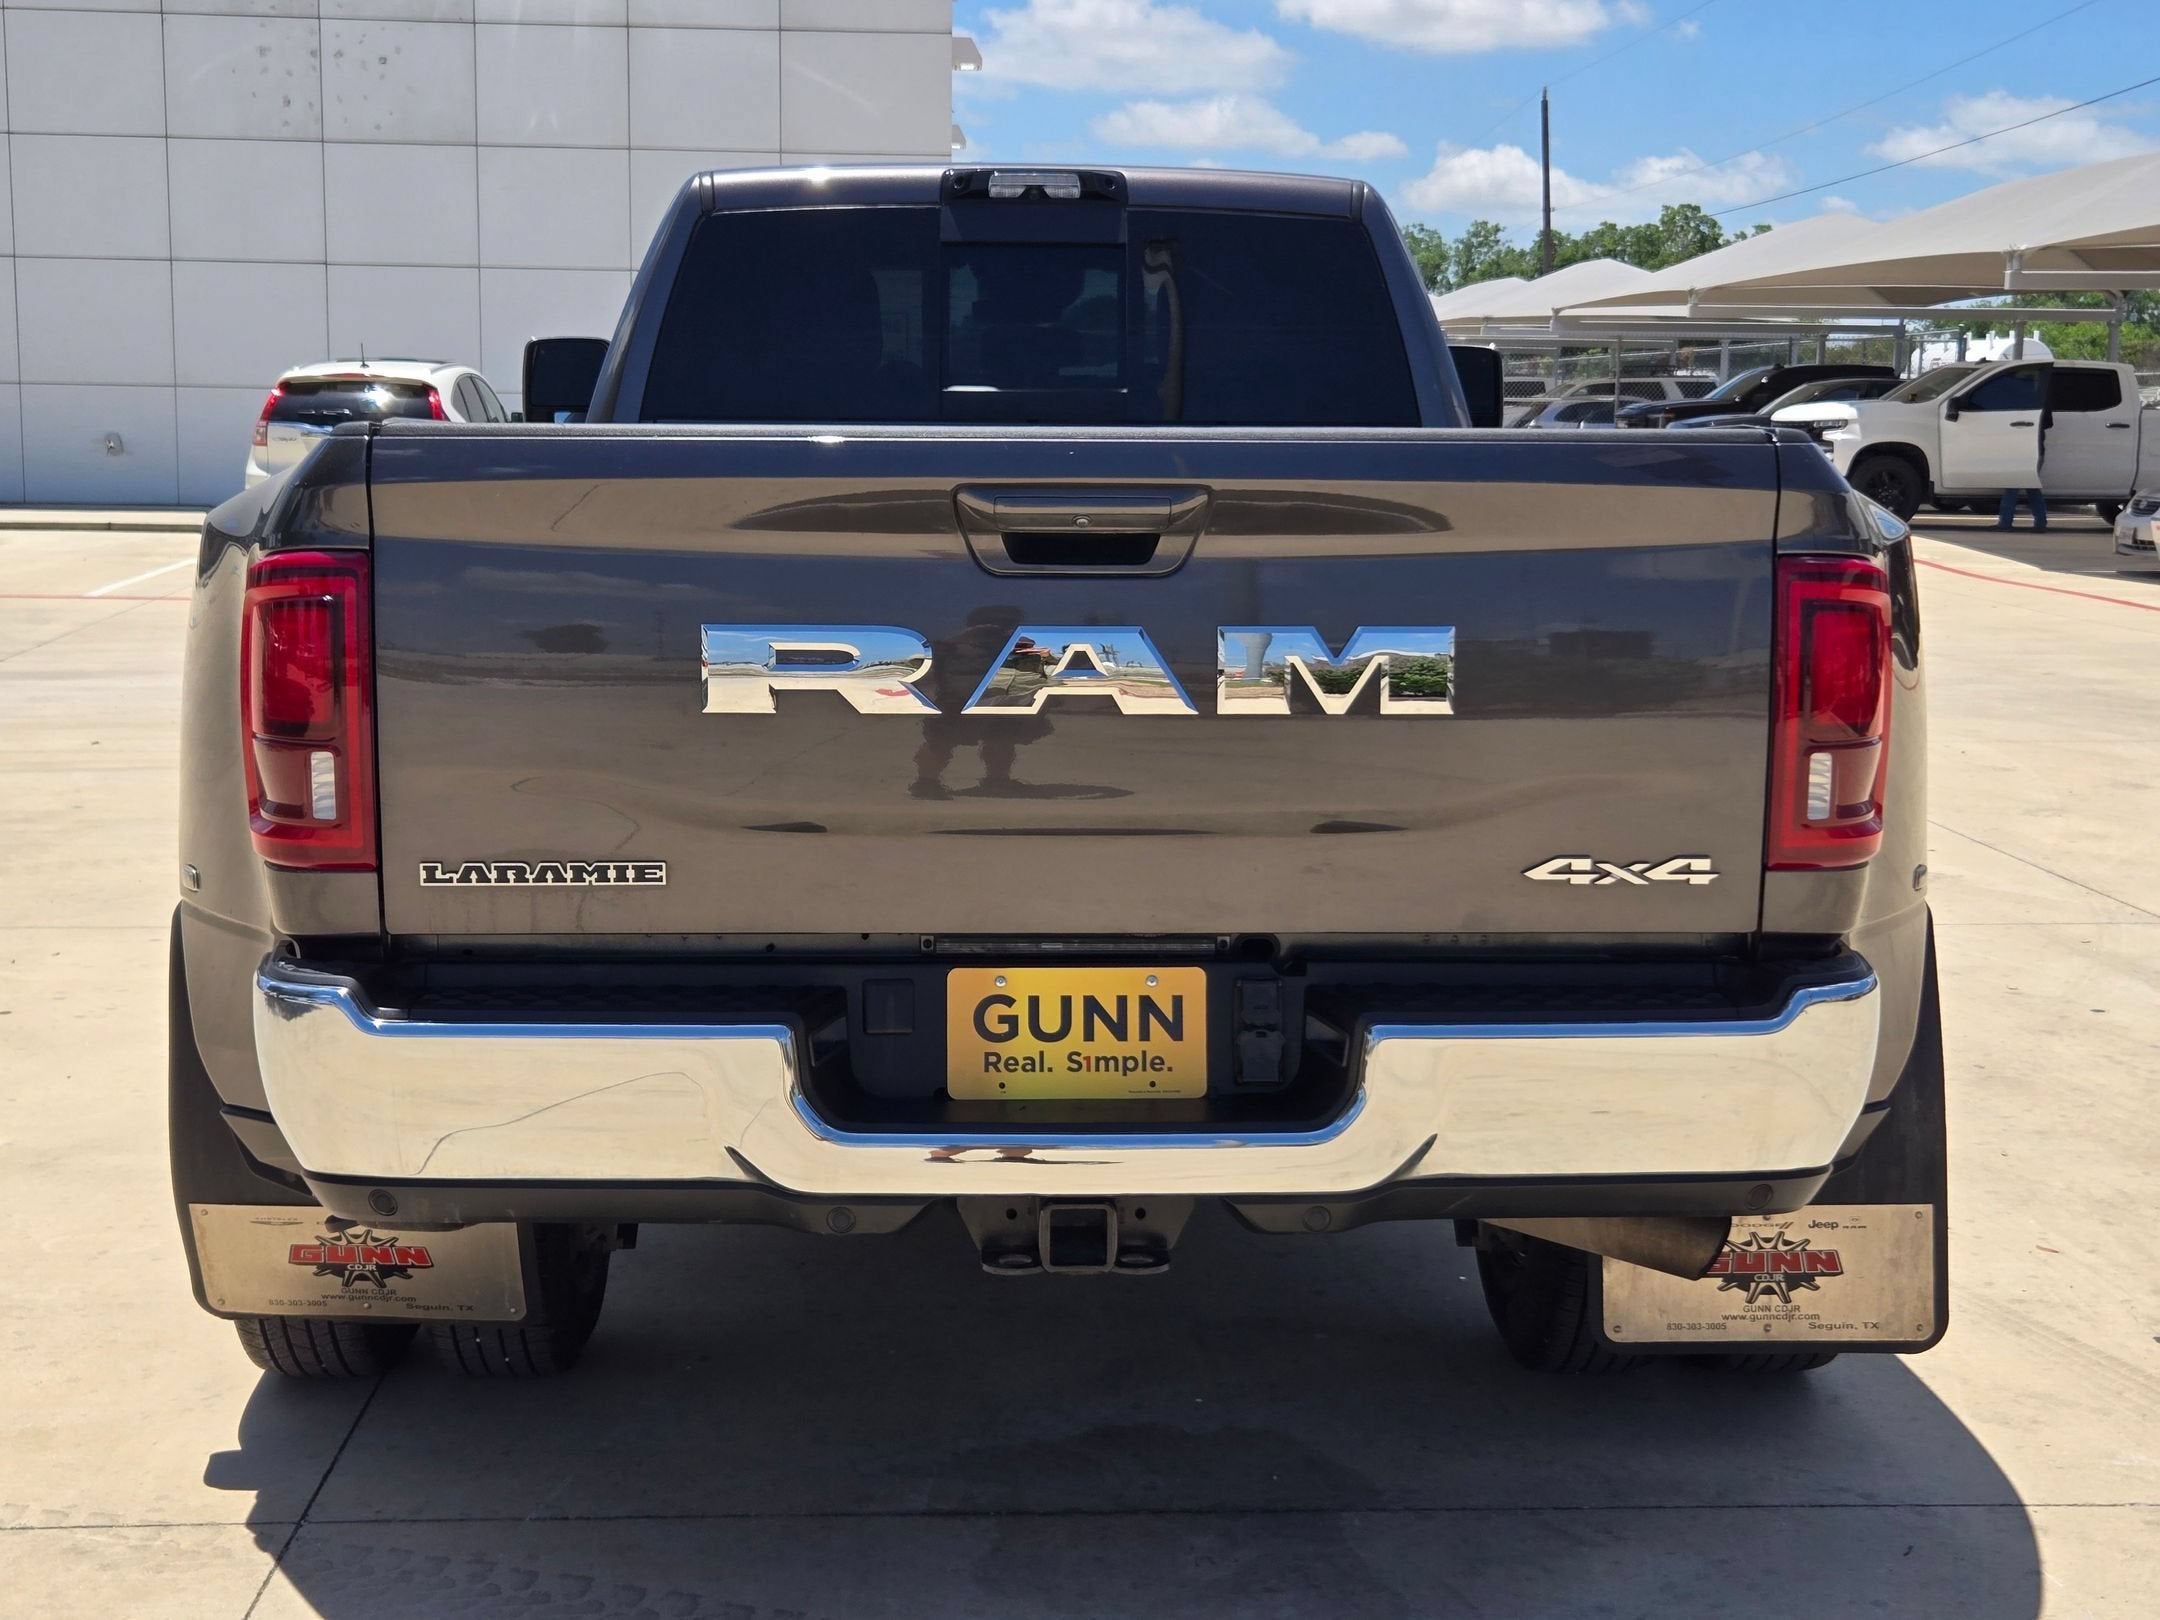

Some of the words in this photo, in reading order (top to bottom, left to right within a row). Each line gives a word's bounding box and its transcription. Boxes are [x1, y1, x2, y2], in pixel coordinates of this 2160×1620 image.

[701, 624, 1456, 715] RAM
[419, 861, 667, 886] LARAMIE
[973, 994, 1184, 1043] GUNN
[984, 1051, 1053, 1073] Real.
[1808, 1220, 1839, 1230] Jeep
[289, 1244, 434, 1267] GUNN
[1754, 1274, 1784, 1282] CDJR
[341, 1287, 369, 1295] GUNN
[372, 1288, 397, 1296] CDJR
[321, 1294, 417, 1304] www.gunncdjr.com
[1743, 1305, 1771, 1313] GUNN
[1774, 1305, 1801, 1313] CDJR
[1721, 1312, 1820, 1322] www.gunncdjr.com
